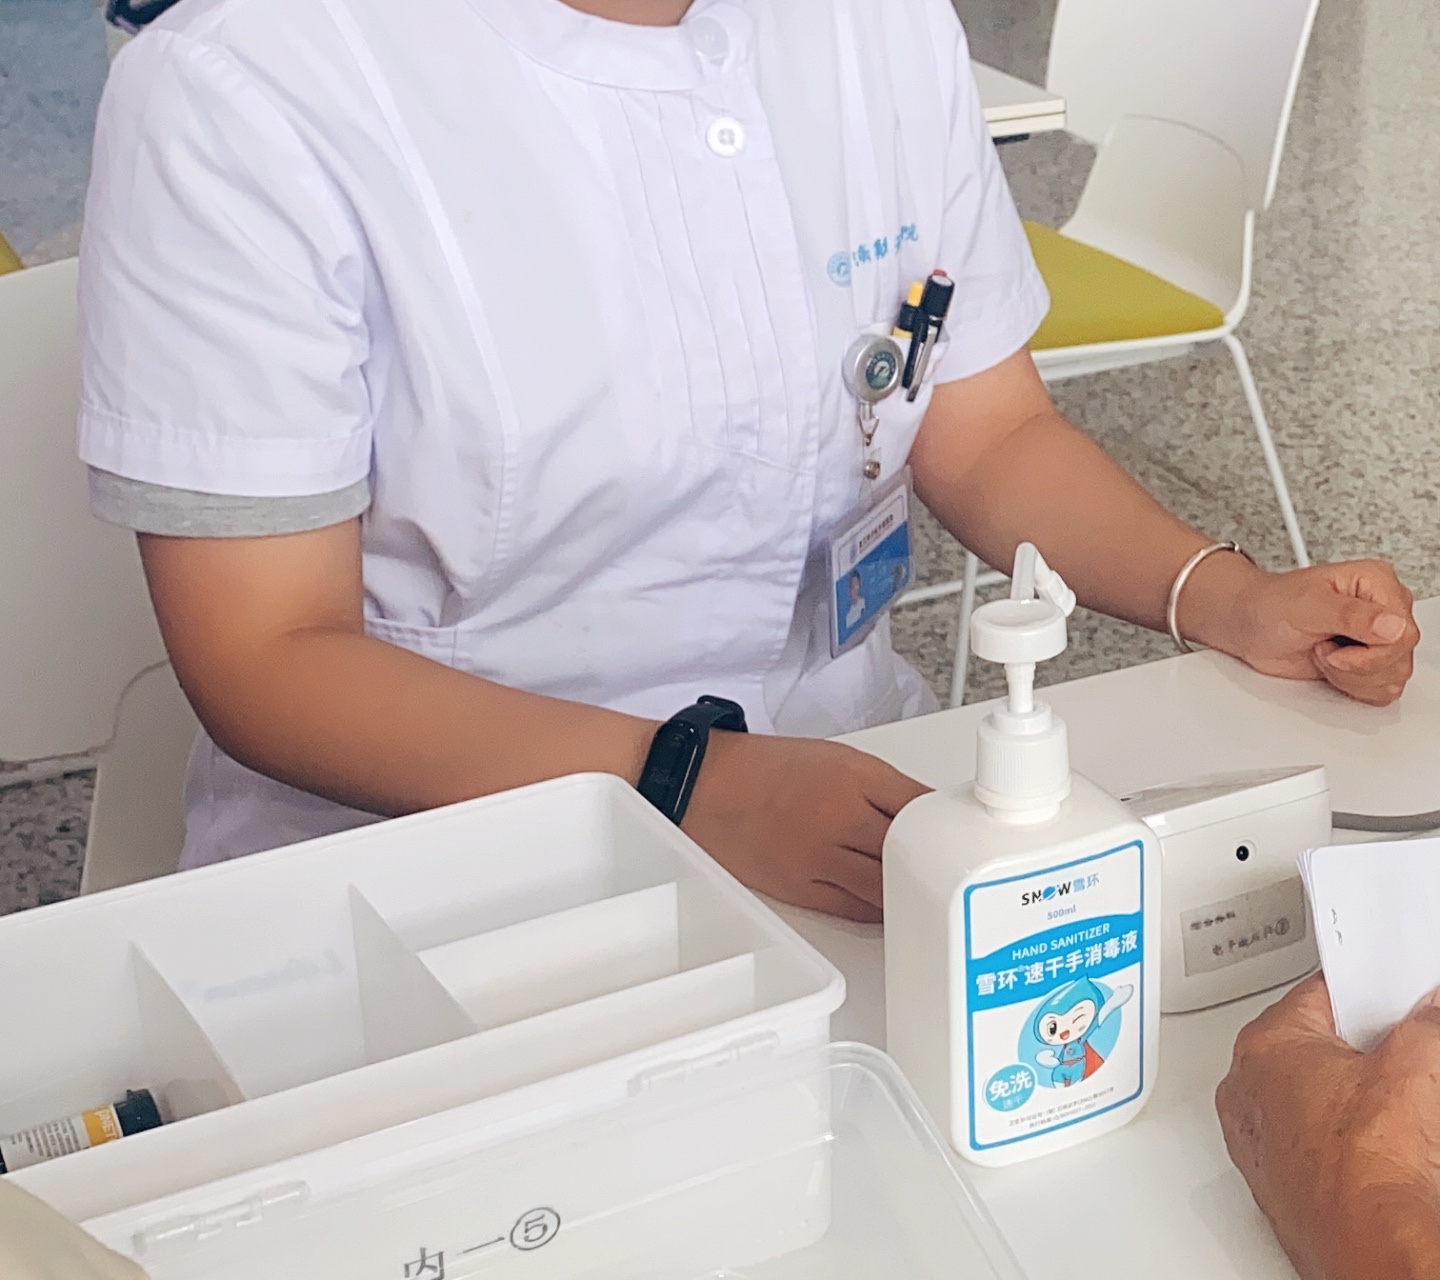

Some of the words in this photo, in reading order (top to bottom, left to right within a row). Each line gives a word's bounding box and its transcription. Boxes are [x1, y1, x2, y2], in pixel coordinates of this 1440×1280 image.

[1047, 904, 1077, 921] 500ml
[1012, 942, 1048, 961] HAND
[1050, 922, 1111, 951] SANITIZER
[988, 1070, 1034, 1103] 免洗
